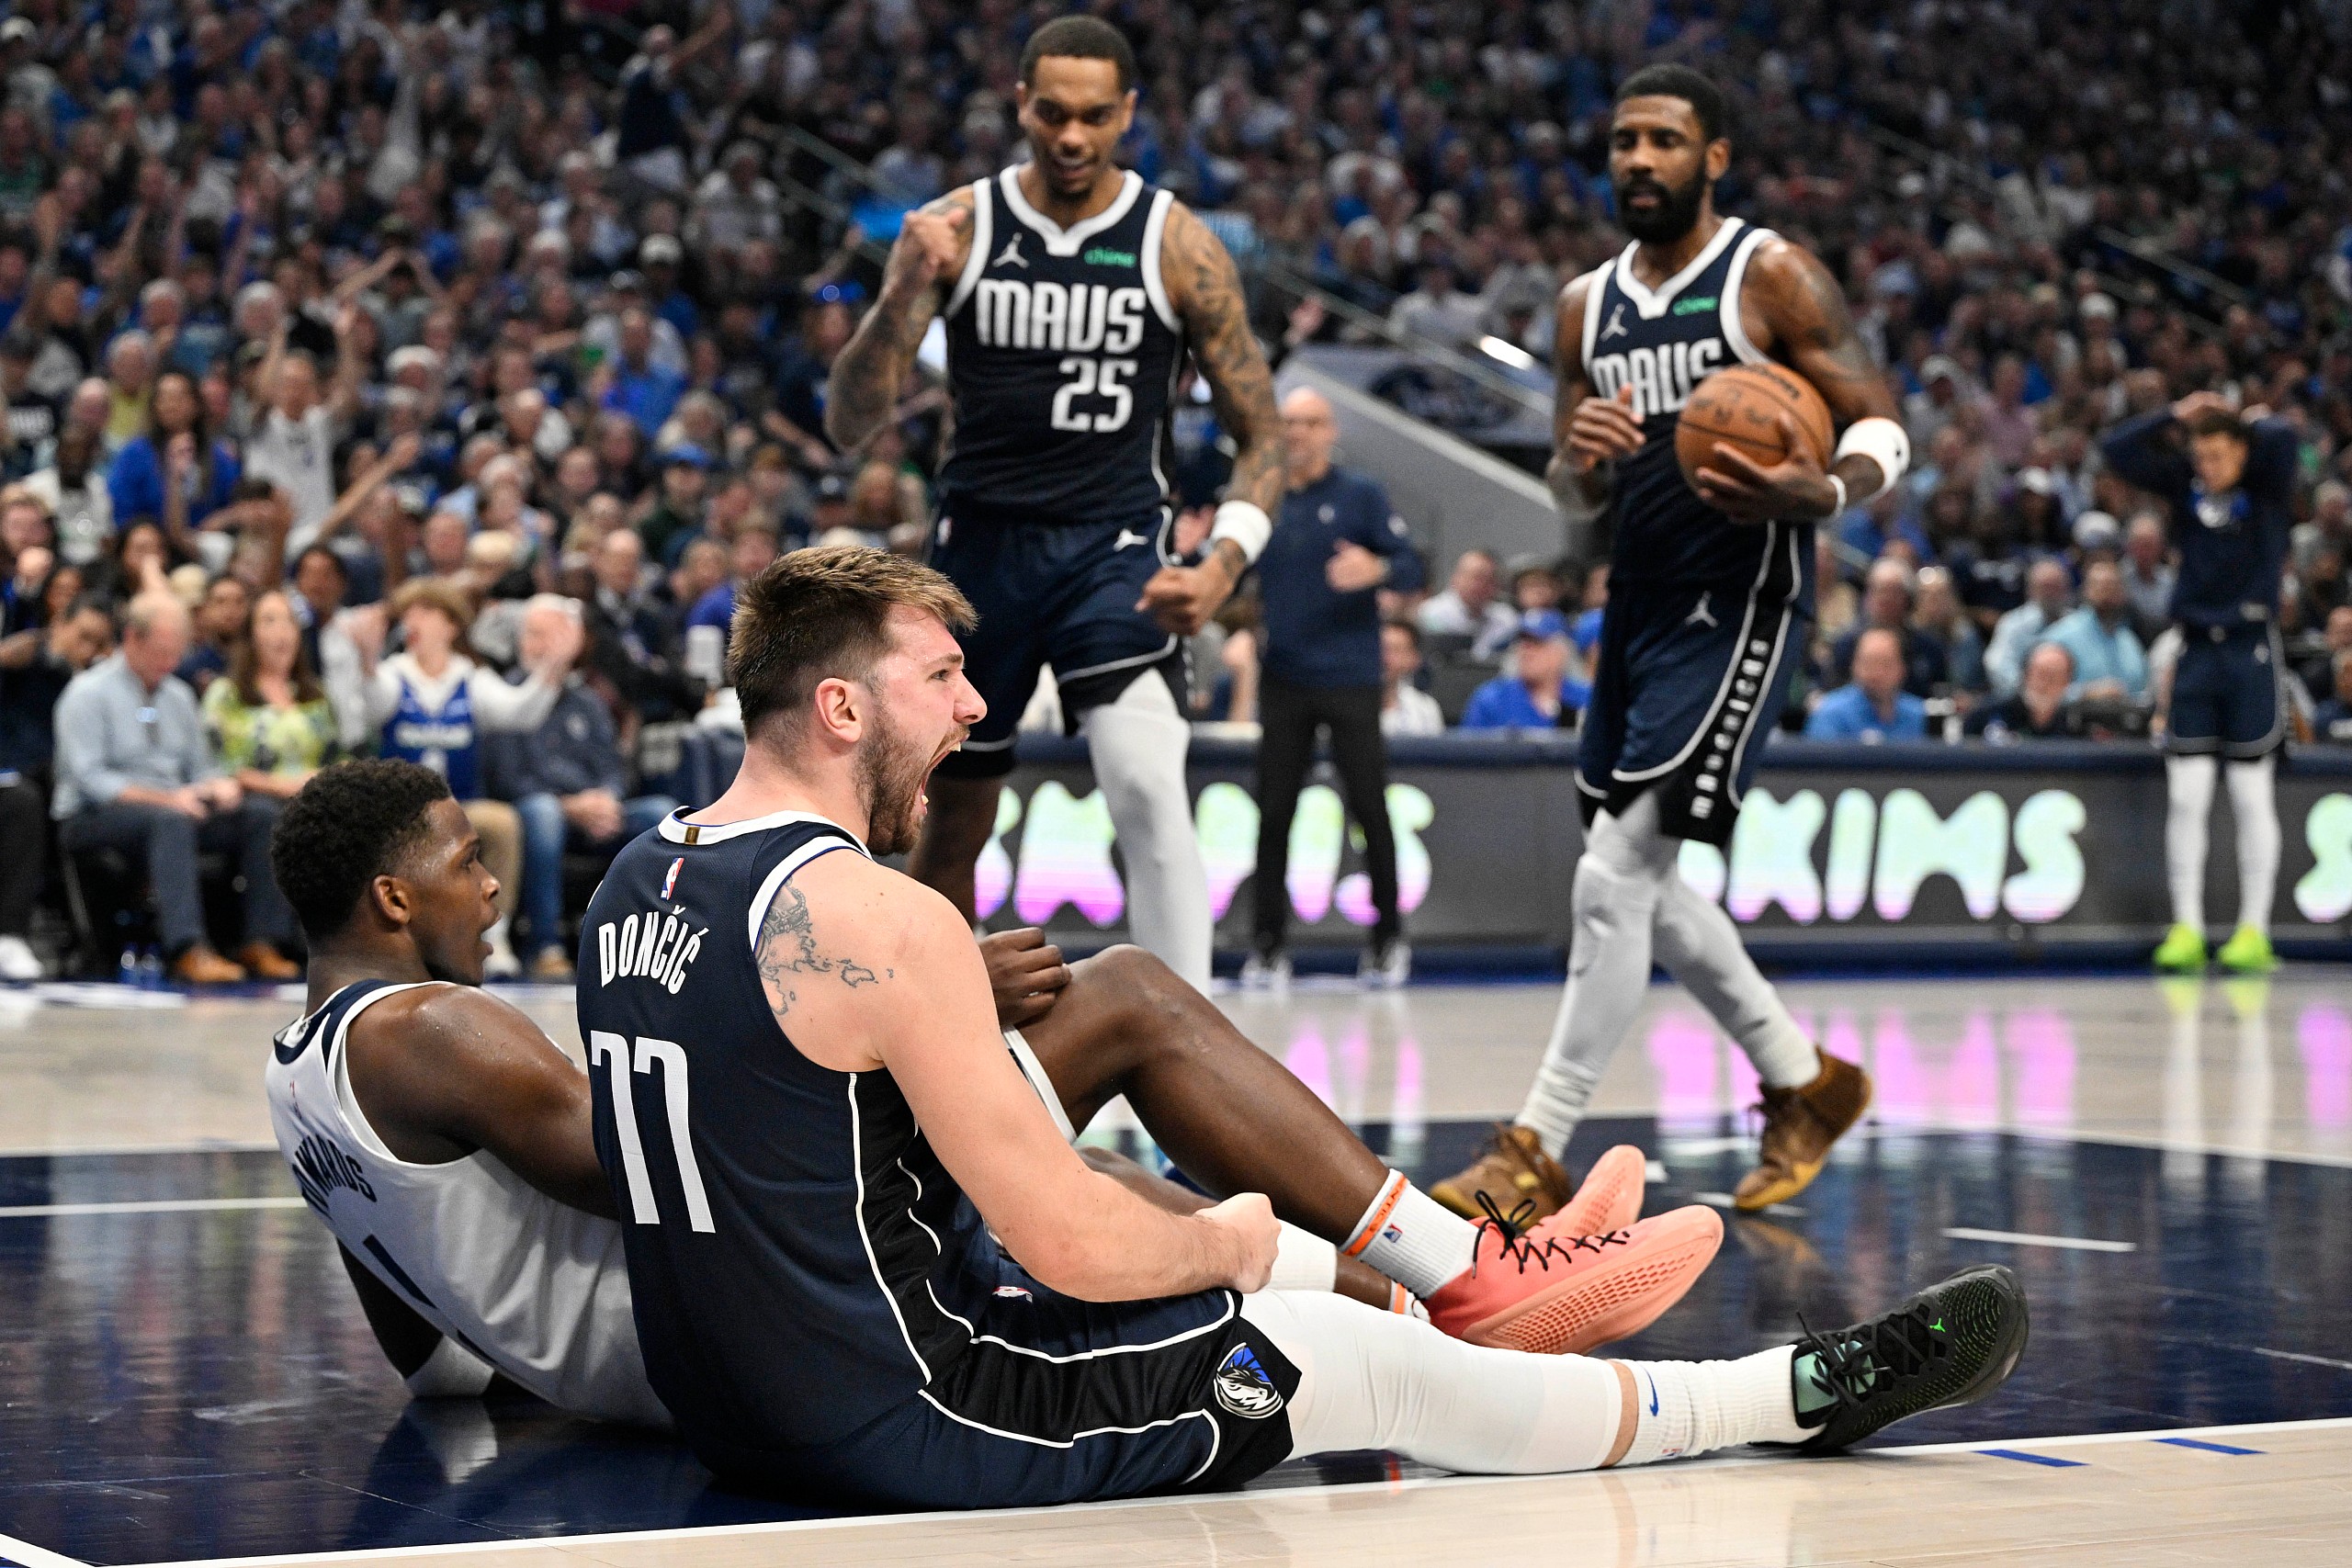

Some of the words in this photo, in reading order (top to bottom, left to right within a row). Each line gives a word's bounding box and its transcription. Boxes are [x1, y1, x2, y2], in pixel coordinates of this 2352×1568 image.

[976, 277, 1147, 355] MAVS
[1050, 356, 1139, 433] 25
[598, 905, 709, 995] DONČIĆ
[591, 1030, 716, 1234] 77
